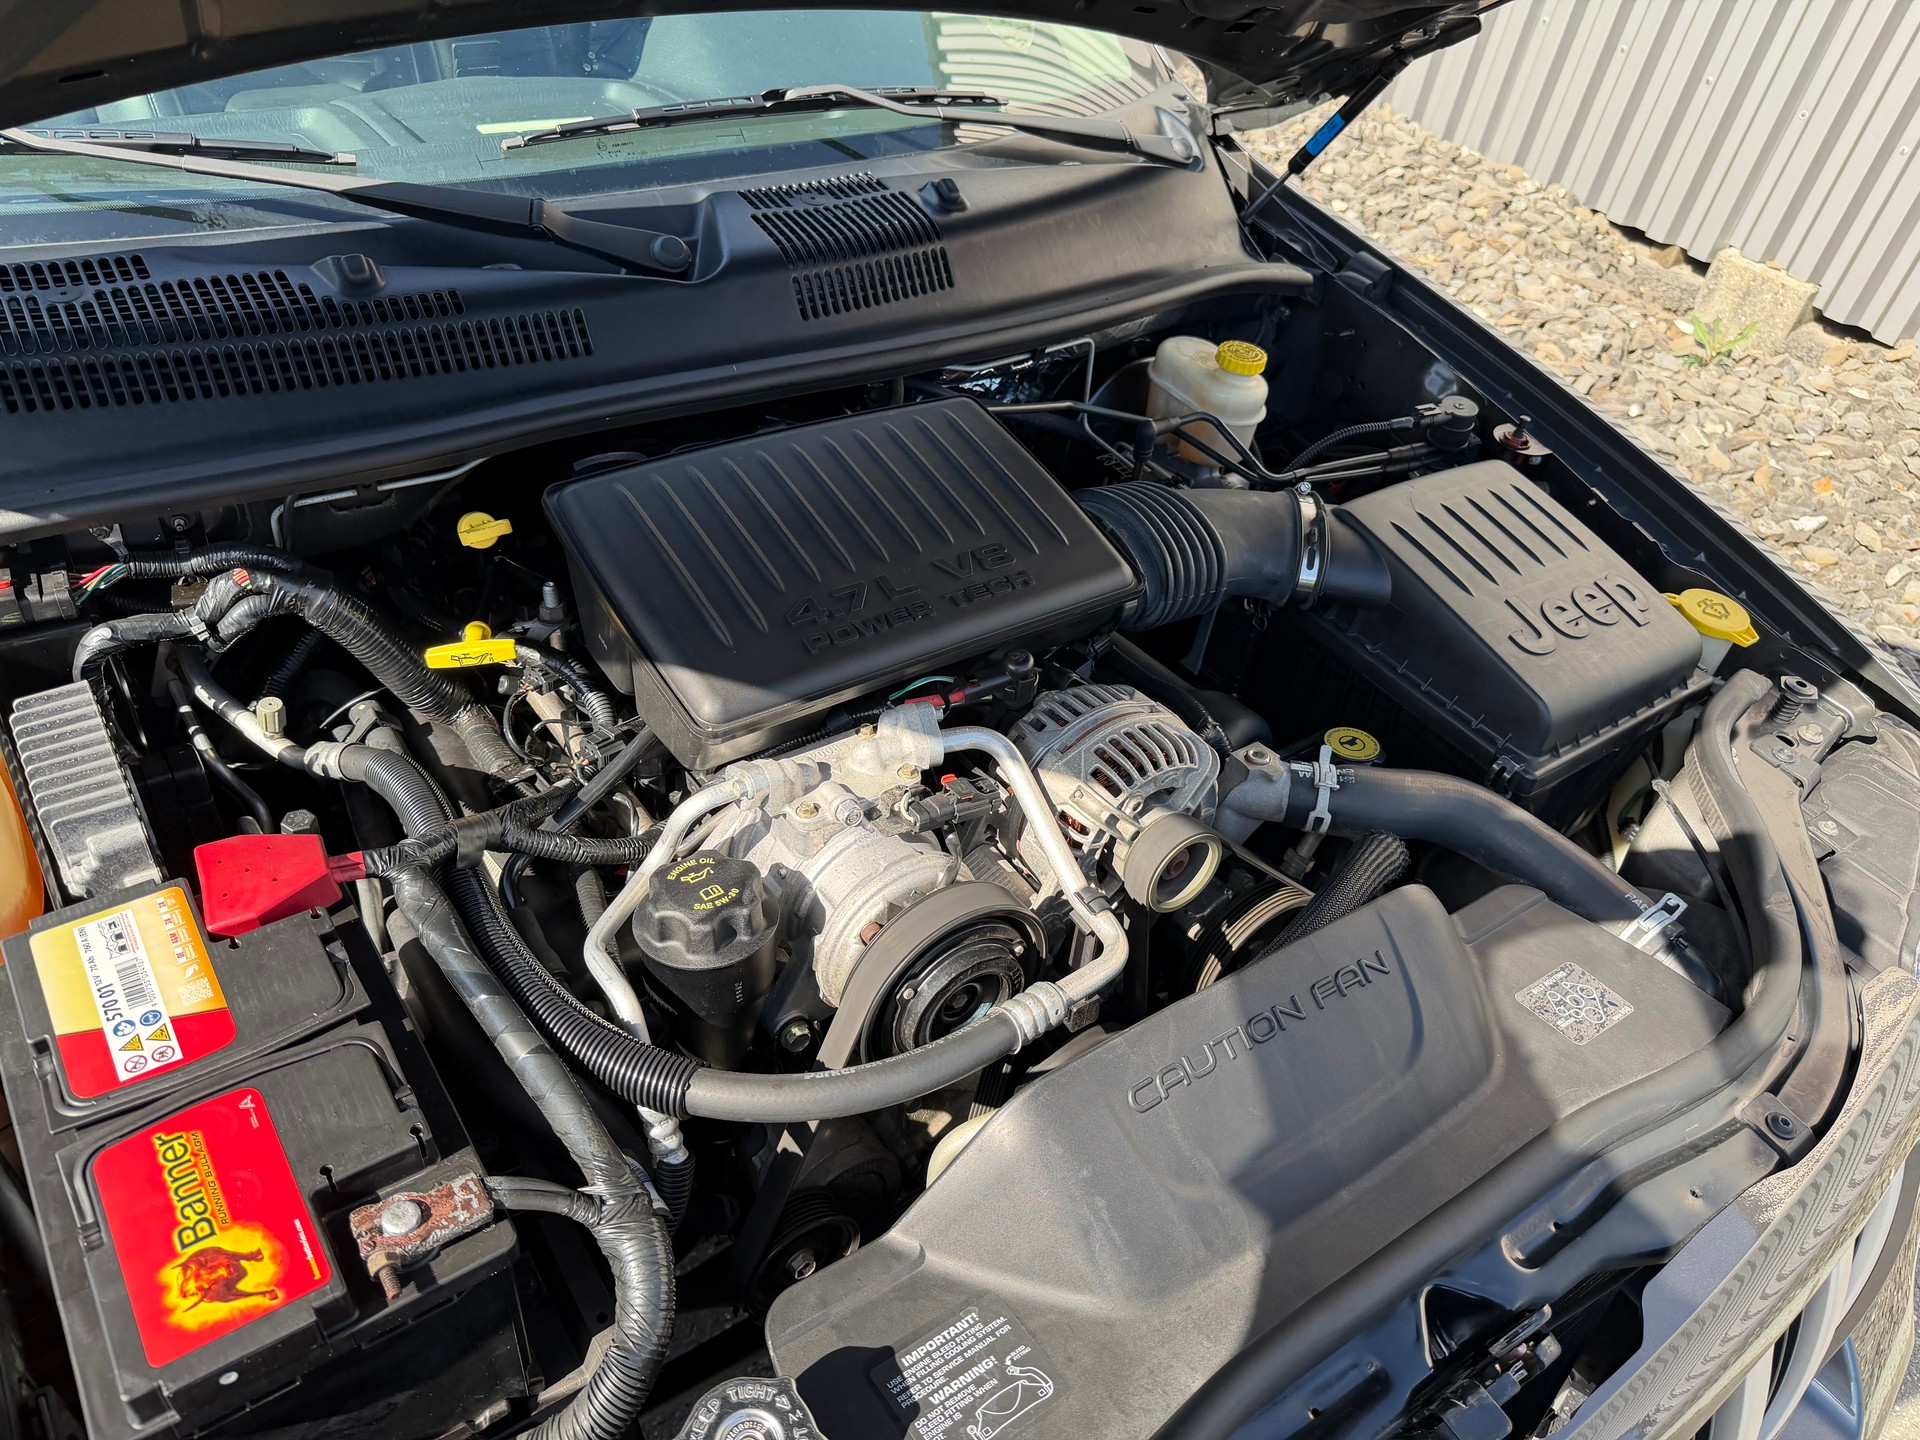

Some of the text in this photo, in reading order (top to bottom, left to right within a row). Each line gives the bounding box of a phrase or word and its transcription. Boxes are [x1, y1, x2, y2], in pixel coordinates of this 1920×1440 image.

[932, 542, 1016, 578] V8
[802, 569, 1036, 654] POWER TECH
[1504, 573, 1651, 656] Jeep
[667, 859, 697, 880] ENGINE
[693, 888, 740, 910] SAE 5W-30
[97, 983, 116, 999] 01
[102, 999, 123, 1022] 570
[1127, 950, 1391, 1113] CAUTION FAN
[154, 1133, 218, 1252] Banner
[190, 1132, 229, 1225] RUNNING BULL AGM
[887, 1322, 984, 1389] USE ENGINE BLEED FITTING
[890, 1316, 1008, 1394] WHEN FILLING COOLING SYSTEM.
[896, 1324, 1012, 1403] REFER TO SERVICE MANUAL FOR
[900, 1312, 980, 1366] IMPORTANT!
[1010, 1345, 1026, 1357] BLEED
[726, 1384, 778, 1403] TIGHT
[900, 1376, 949, 1409] PROCEDURE.
[928, 1355, 998, 1405] WARNING!
[914, 1383, 977, 1429] DO NOT REMOVE
[918, 1378, 999, 1435] BLEED FITTING WHEN
[922, 1411, 963, 1440] ENGINE IS
